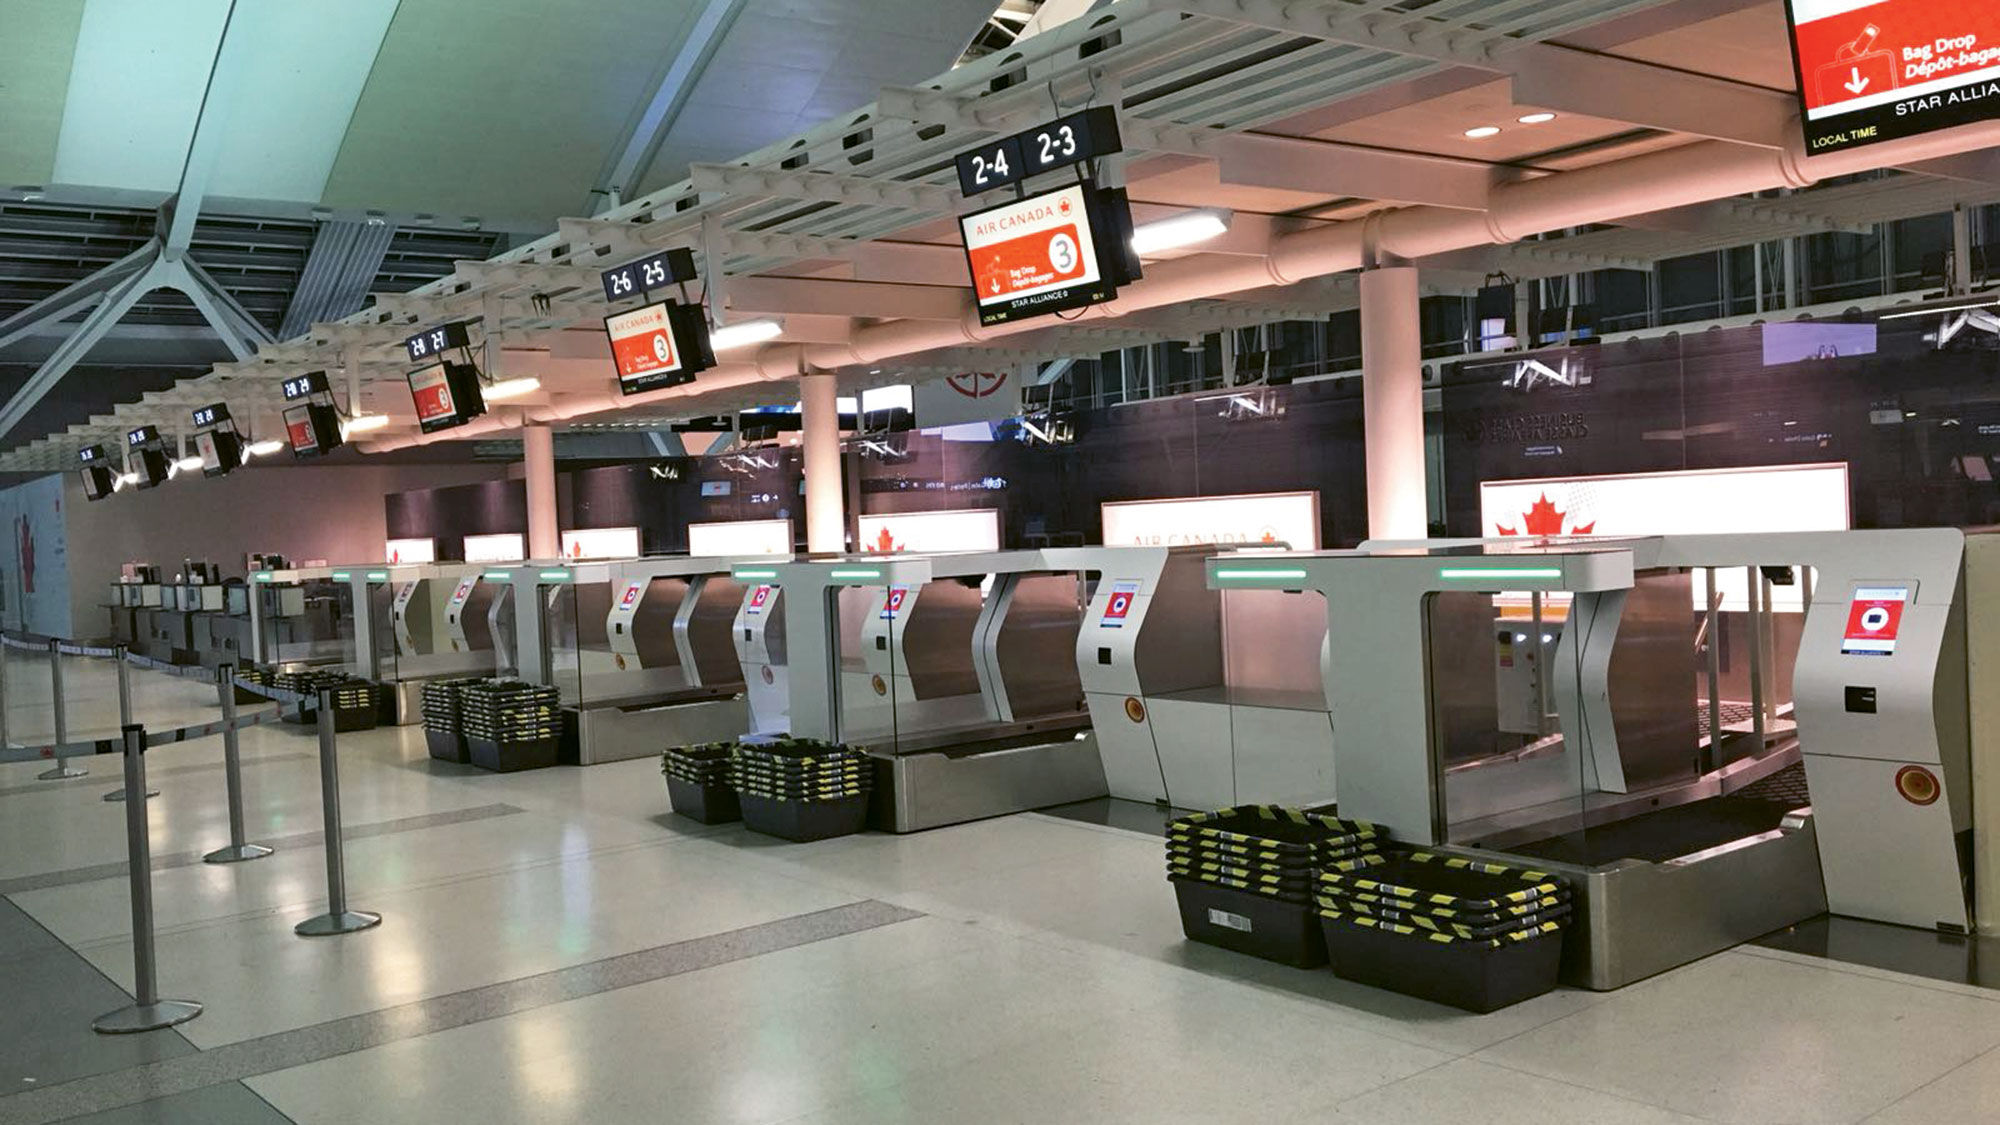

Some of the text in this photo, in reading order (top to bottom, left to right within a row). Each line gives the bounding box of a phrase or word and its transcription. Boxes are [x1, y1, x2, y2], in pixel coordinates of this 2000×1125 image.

[1902, 34, 1976, 61] Bag Drop
[1905, 46, 2000, 79] Dépôt-baga
[1895, 95, 1942, 116] STAR
[1813, 126, 1877, 149] LOCAL TIME
[972, 125, 1076, 185] 2-4 2-3
[976, 205, 1054, 236] AIR CANADA
[1056, 239, 1072, 269] 3
[611, 260, 665, 295] 2-6 2-5
[1011, 291, 1063, 308] STAR ALLIANCE
[656, 338, 667, 360] 3
